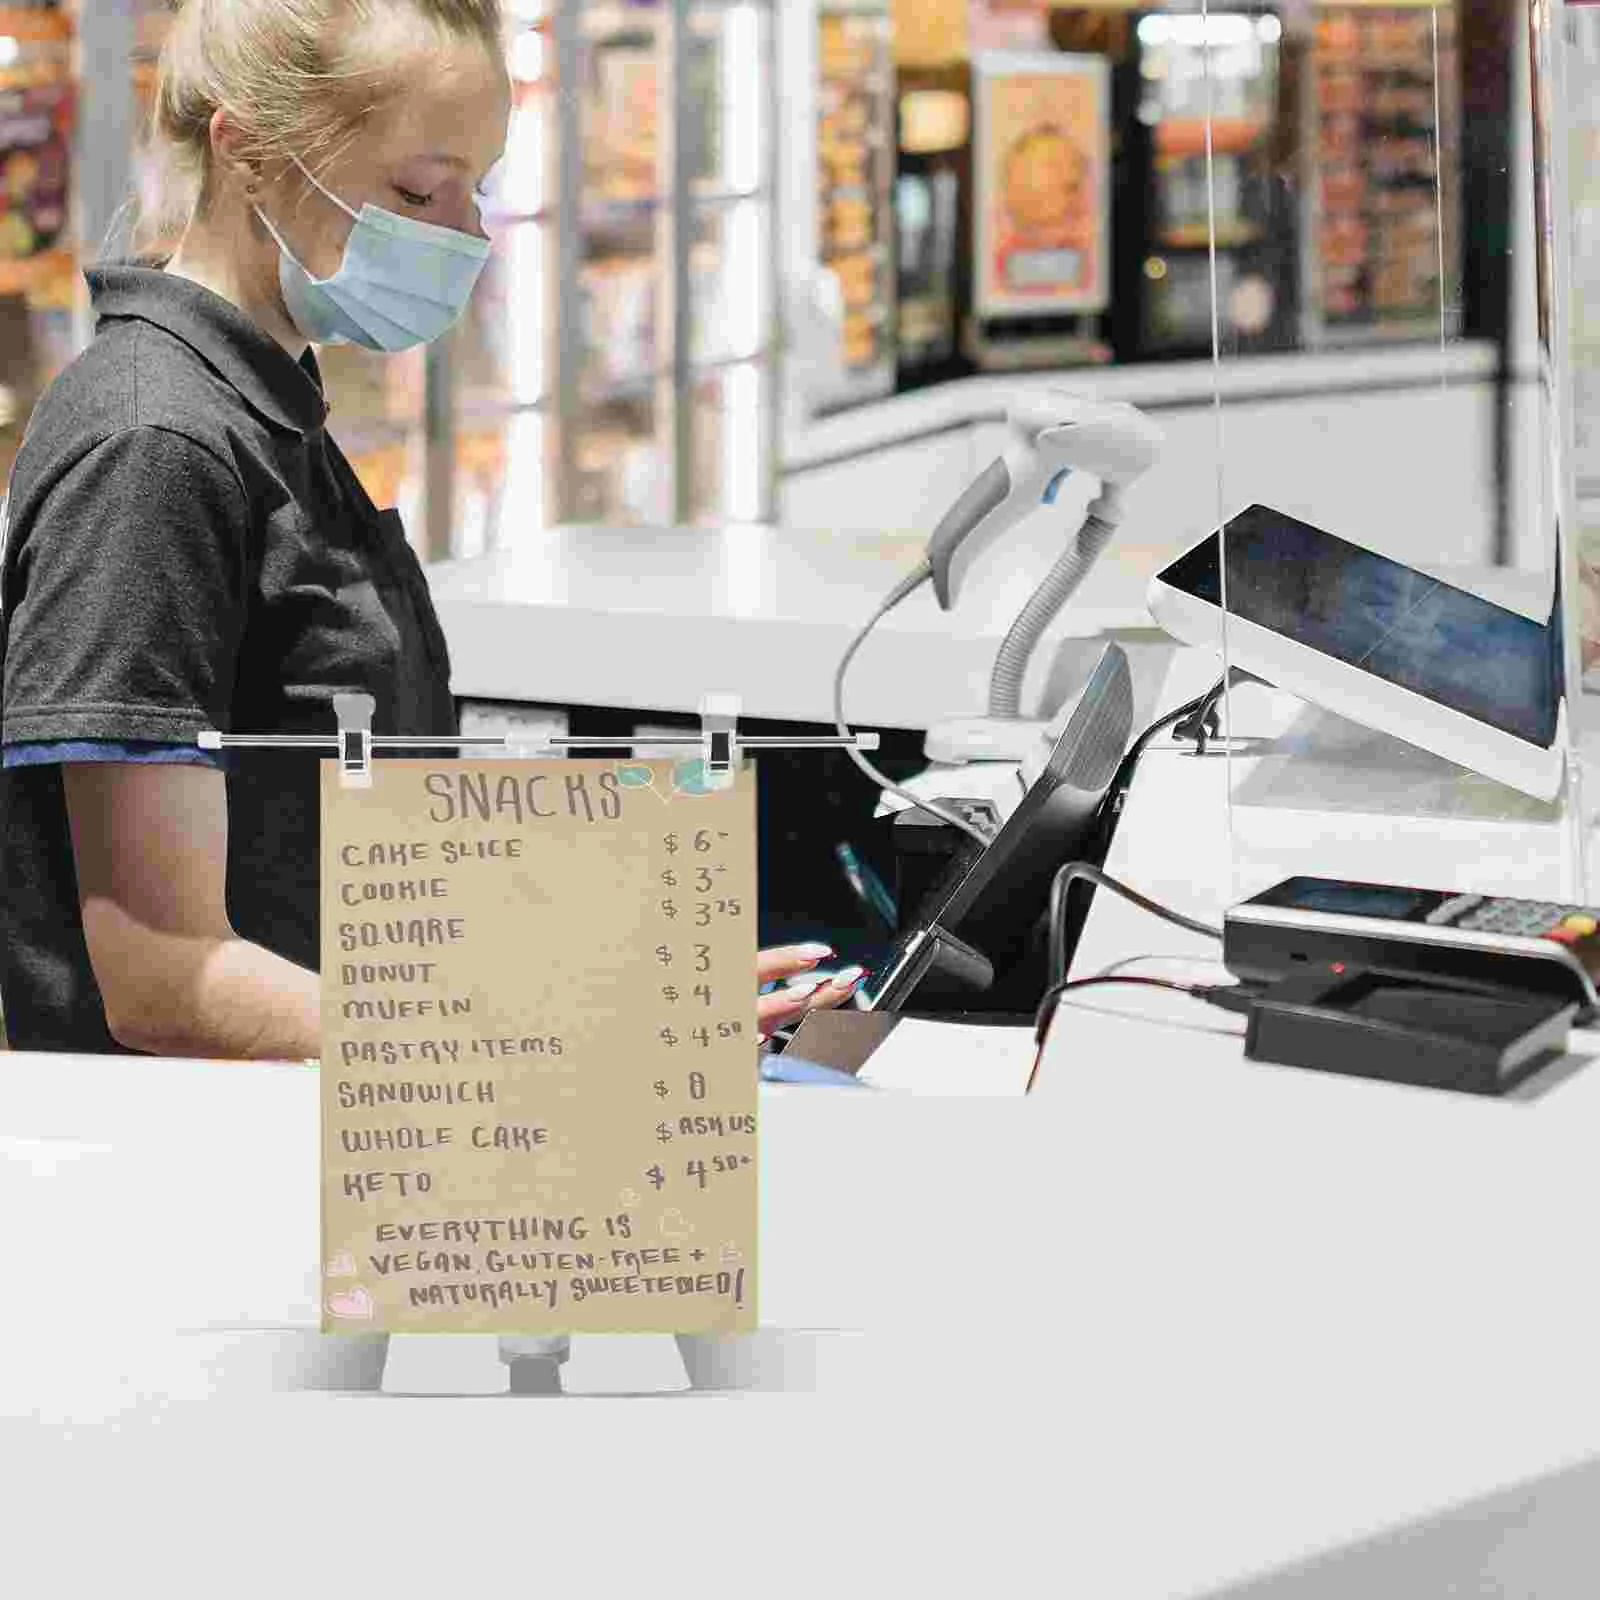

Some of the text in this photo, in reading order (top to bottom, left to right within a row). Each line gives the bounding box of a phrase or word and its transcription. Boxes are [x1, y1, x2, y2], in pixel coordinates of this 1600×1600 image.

[424, 771, 622, 824] SNACKS
[341, 843, 429, 866] CAKE
[440, 839, 523, 864] SLICE
[341, 877, 449, 906] COOKIE
[338, 917, 466, 952] SQUARE
[342, 963, 437, 985] DONUT
[694, 943, 711, 972] 3
[343, 998, 472, 1020] MUFFIN
[693, 984, 711, 1007] 4
[341, 1038, 460, 1066] PASTRY
[471, 1036, 564, 1058] ITEMS
[338, 1080, 496, 1108] SANDWICH
[341, 1127, 453, 1152] WHOLE
[471, 1125, 550, 1151] CAKE
[679, 1116, 724, 1137] ASK
[729, 1114, 756, 1135] US
[343, 1171, 432, 1201] KETO
[376, 1213, 632, 1244] EVERYTHING IS
[409, 1278, 558, 1309] NATURALLY
